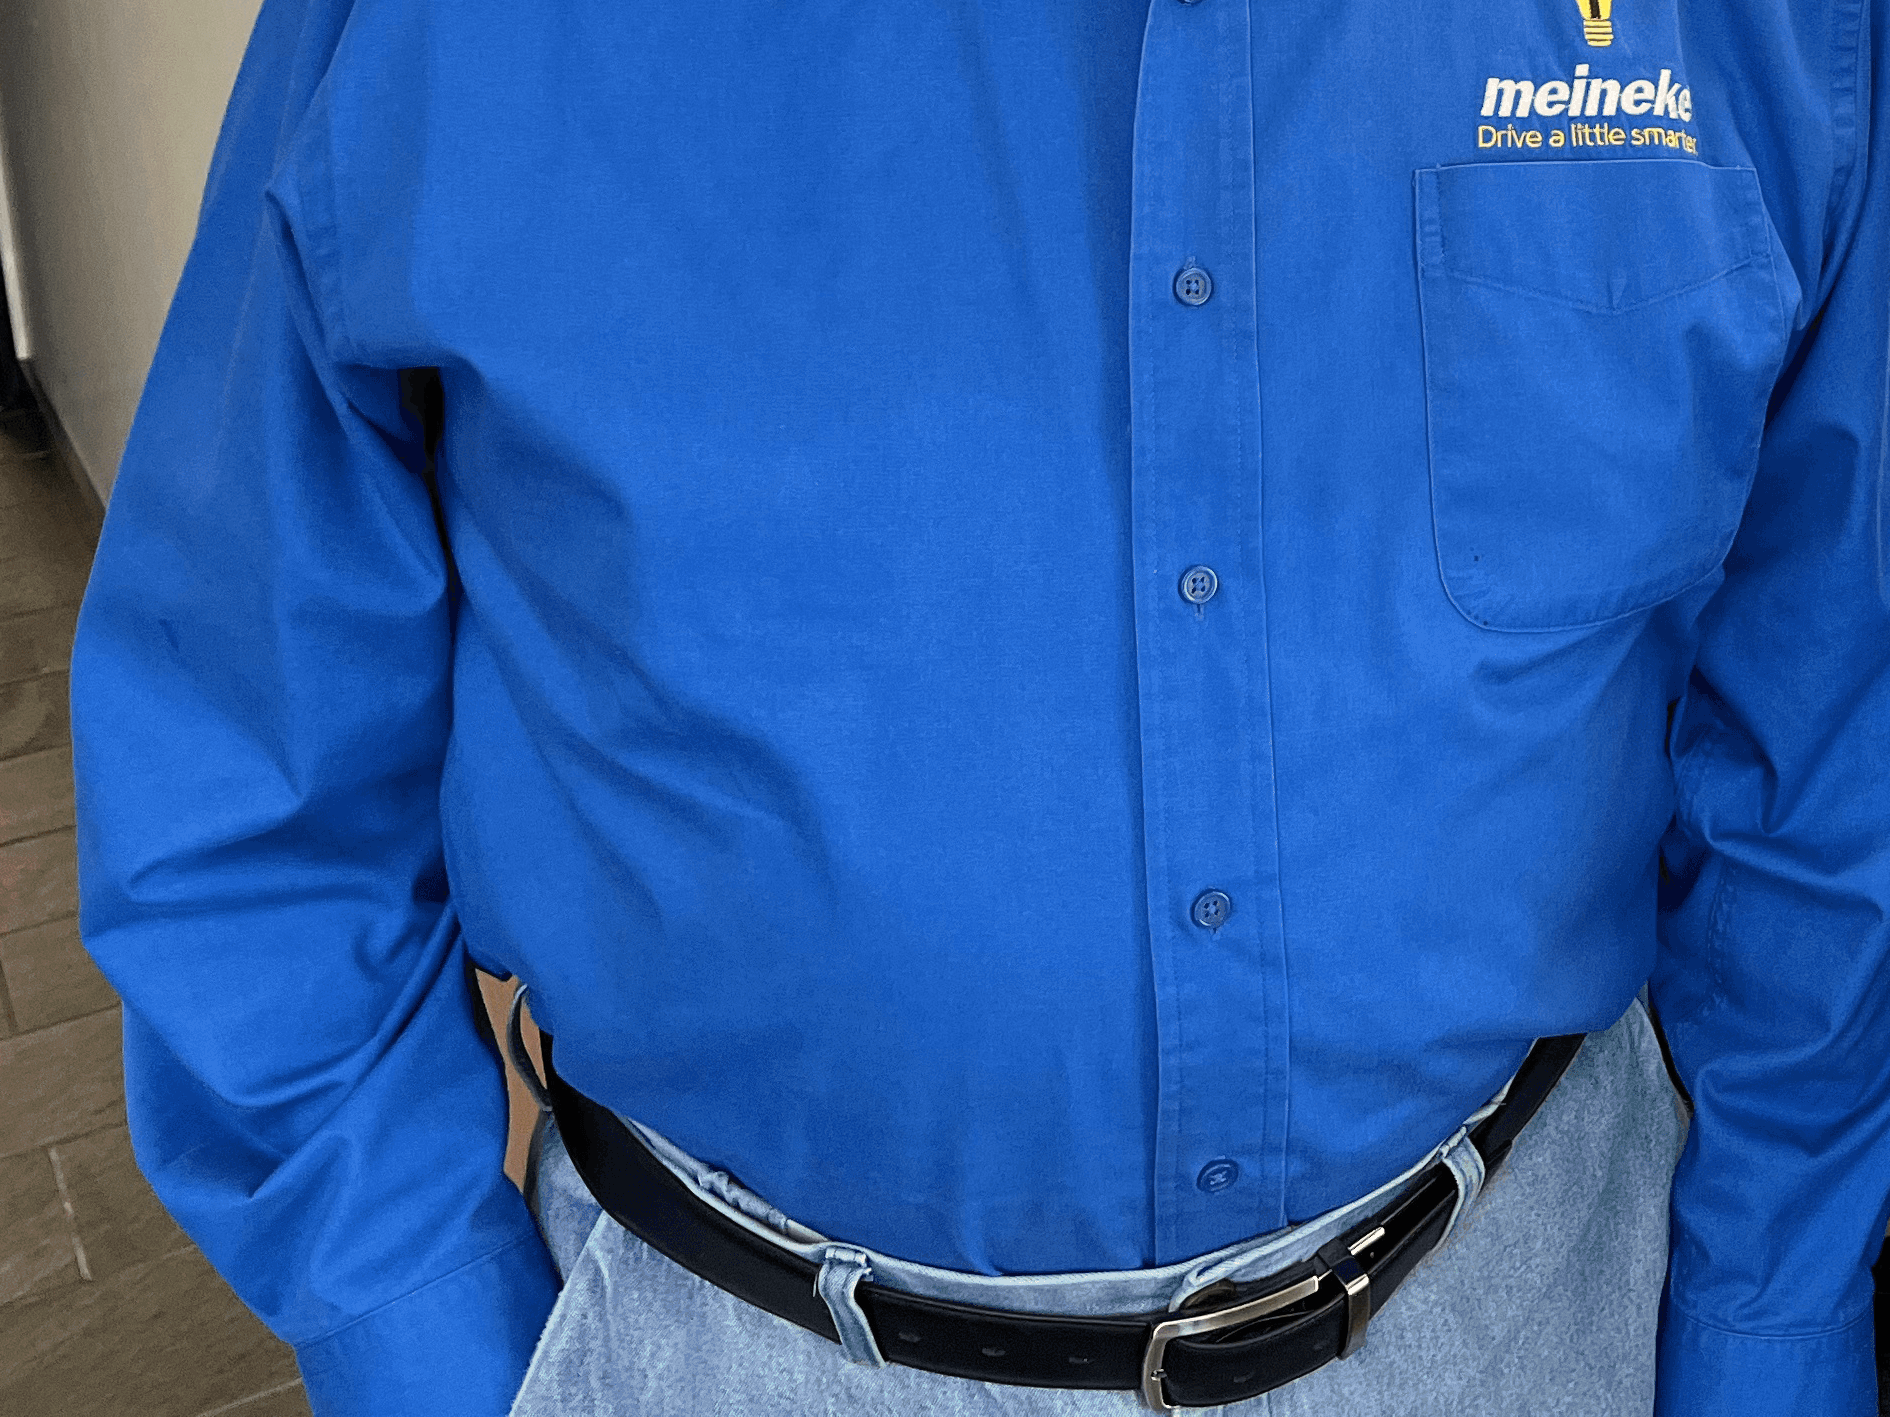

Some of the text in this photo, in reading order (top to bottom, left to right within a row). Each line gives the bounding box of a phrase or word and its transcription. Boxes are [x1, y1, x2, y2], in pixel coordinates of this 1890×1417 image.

[1479, 63, 1693, 123] meineke
[1477, 123, 1543, 149] Drive
[1549, 129, 1565, 148] a
[1571, 122, 1627, 147] little
